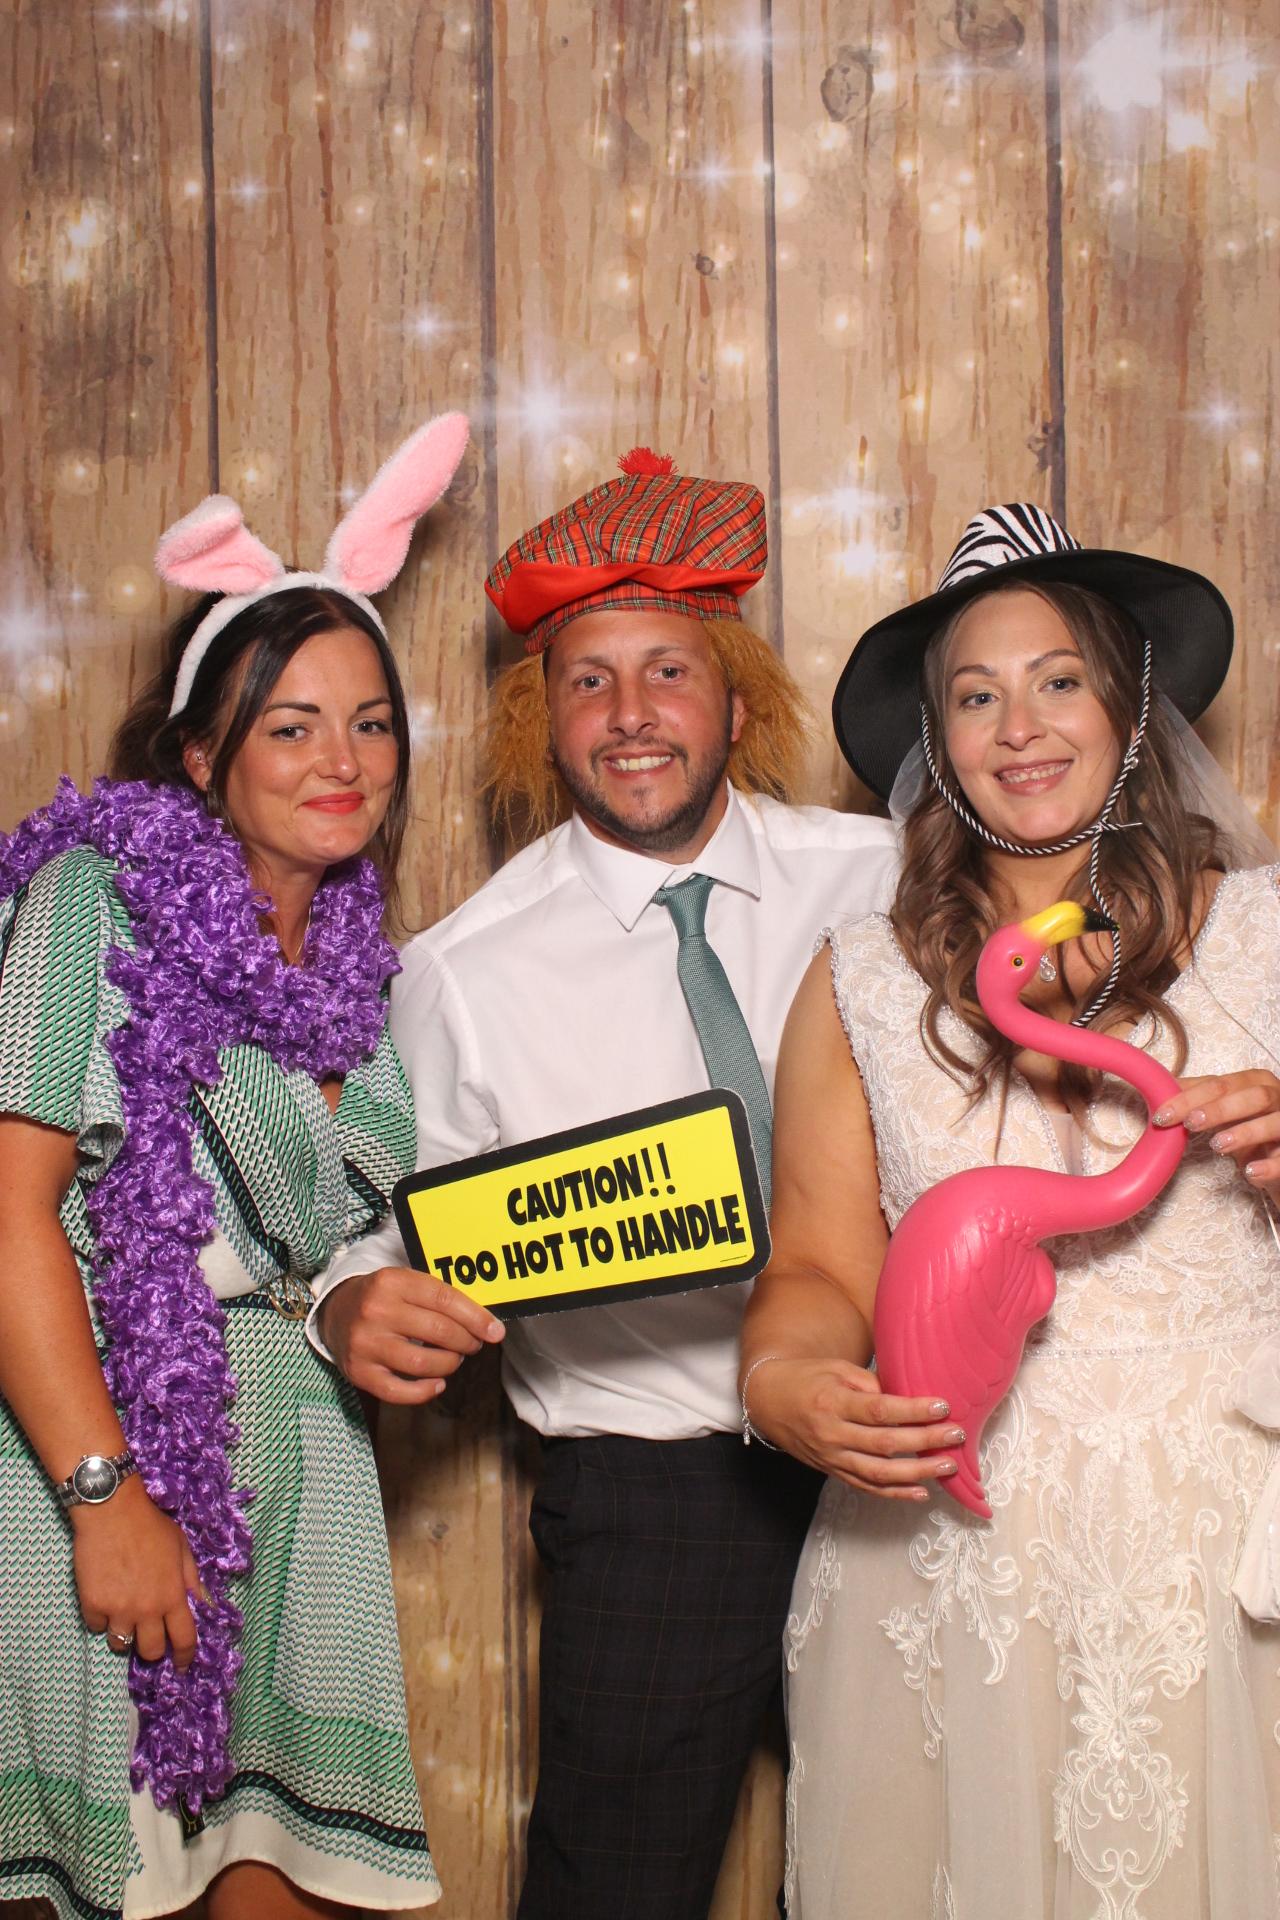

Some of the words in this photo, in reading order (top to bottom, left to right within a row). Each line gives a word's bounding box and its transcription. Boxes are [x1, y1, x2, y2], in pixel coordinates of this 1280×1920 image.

[507, 1143, 676, 1226] CAUTION!!
[434, 1250, 498, 1286] TOO
[502, 1233, 564, 1280] HOT
[570, 1226, 614, 1268] TO
[617, 1193, 747, 1262] HANDLE
